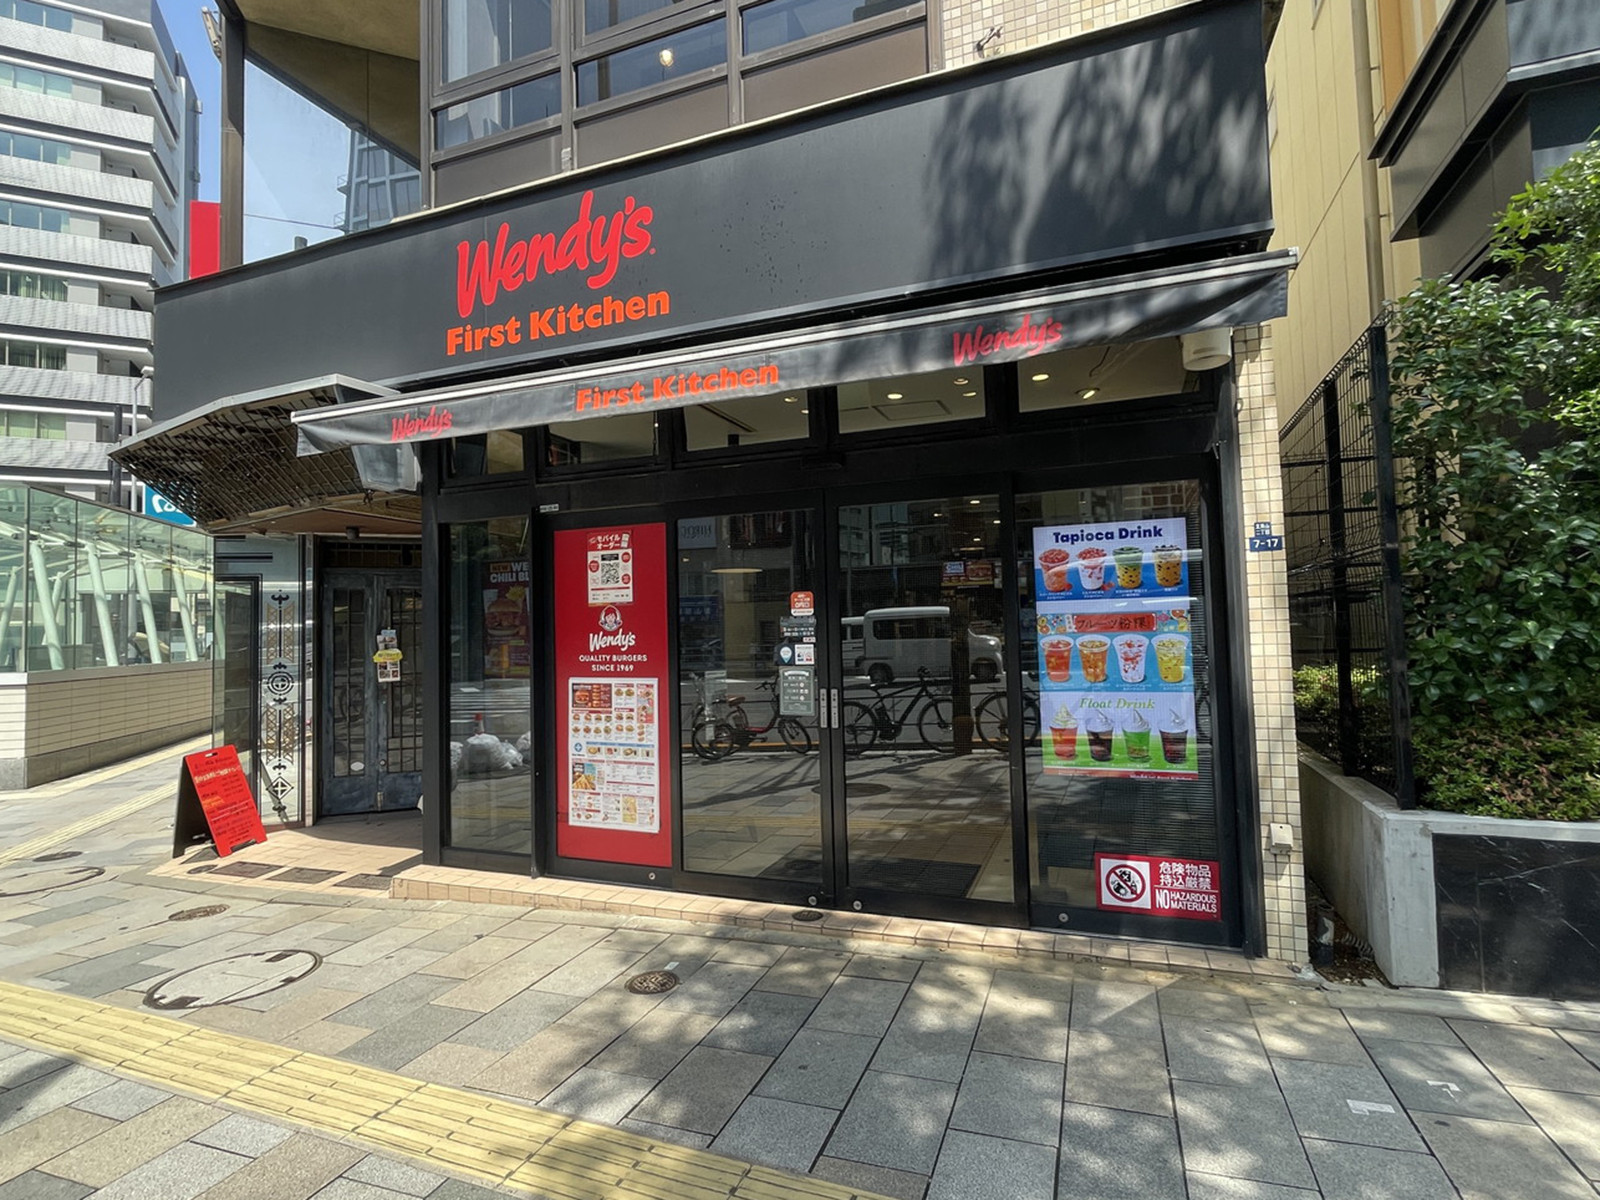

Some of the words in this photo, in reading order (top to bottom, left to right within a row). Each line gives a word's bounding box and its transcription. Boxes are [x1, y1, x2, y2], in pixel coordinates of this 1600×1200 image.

[457, 190, 655, 318] Wendy's
[446, 316, 521, 355] First
[530, 290, 670, 340] Kitchen
[953, 314, 1063, 366] Wendy's
[576, 381, 644, 412] First
[653, 364, 779, 400] Kitchen
[391, 405, 453, 442] Wendy's
[1053, 529, 1114, 545] Tapioca
[1118, 525, 1163, 540] Drink
[1253, 538, 1278, 548] 7-17
[589, 628, 636, 652] Wendy's
[1079, 697, 1112, 709] Float
[1116, 697, 1156, 709] Drink
[1159, 861, 1211, 878] 危険物品
[1159, 874, 1212, 890] 持込厳禁
[1155, 889, 1170, 909] NO
[1171, 891, 1217, 904] HAZARDOUS
[1170, 900, 1217, 913] MATERIALS
